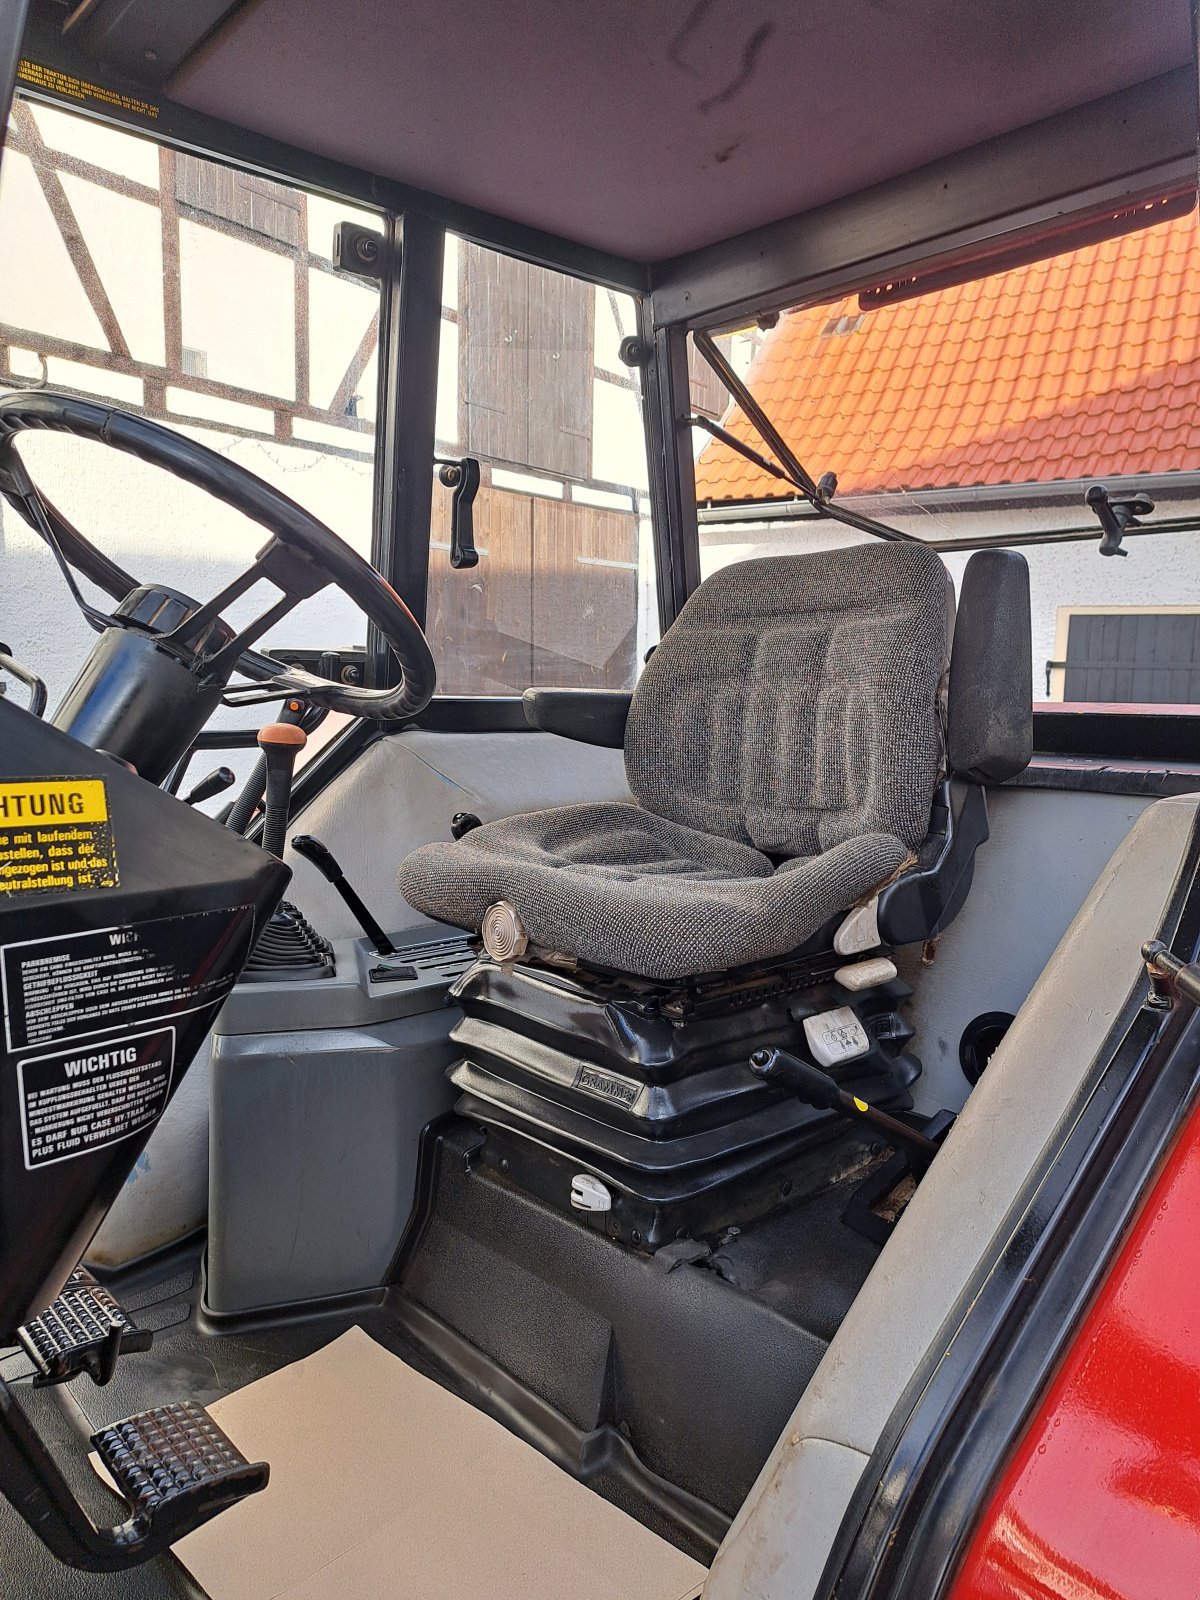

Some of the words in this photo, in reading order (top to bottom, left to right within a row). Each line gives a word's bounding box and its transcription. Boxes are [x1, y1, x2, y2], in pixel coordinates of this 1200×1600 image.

[14, 832, 32, 844] mit
[37, 829, 93, 843] laufendem
[48, 845, 73, 857] dass
[78, 844, 96, 854] der
[51, 860, 65, 871] ist
[68, 858, 86, 870] und
[90, 858, 107, 868] das
[64, 1047, 137, 1077] WICHTIG
[129, 1075, 140, 1083] DER
[44, 1111, 69, 1123] SYSTEM
[32, 1137, 42, 1147] ES
[46, 1130, 67, 1143] DARF
[71, 1125, 88, 1136] NUR
[91, 1118, 112, 1130] CASE
[32, 1145, 54, 1158] PLUS
[57, 1137, 80, 1151] FLUID
[83, 1122, 129, 1144] VERWENDET
